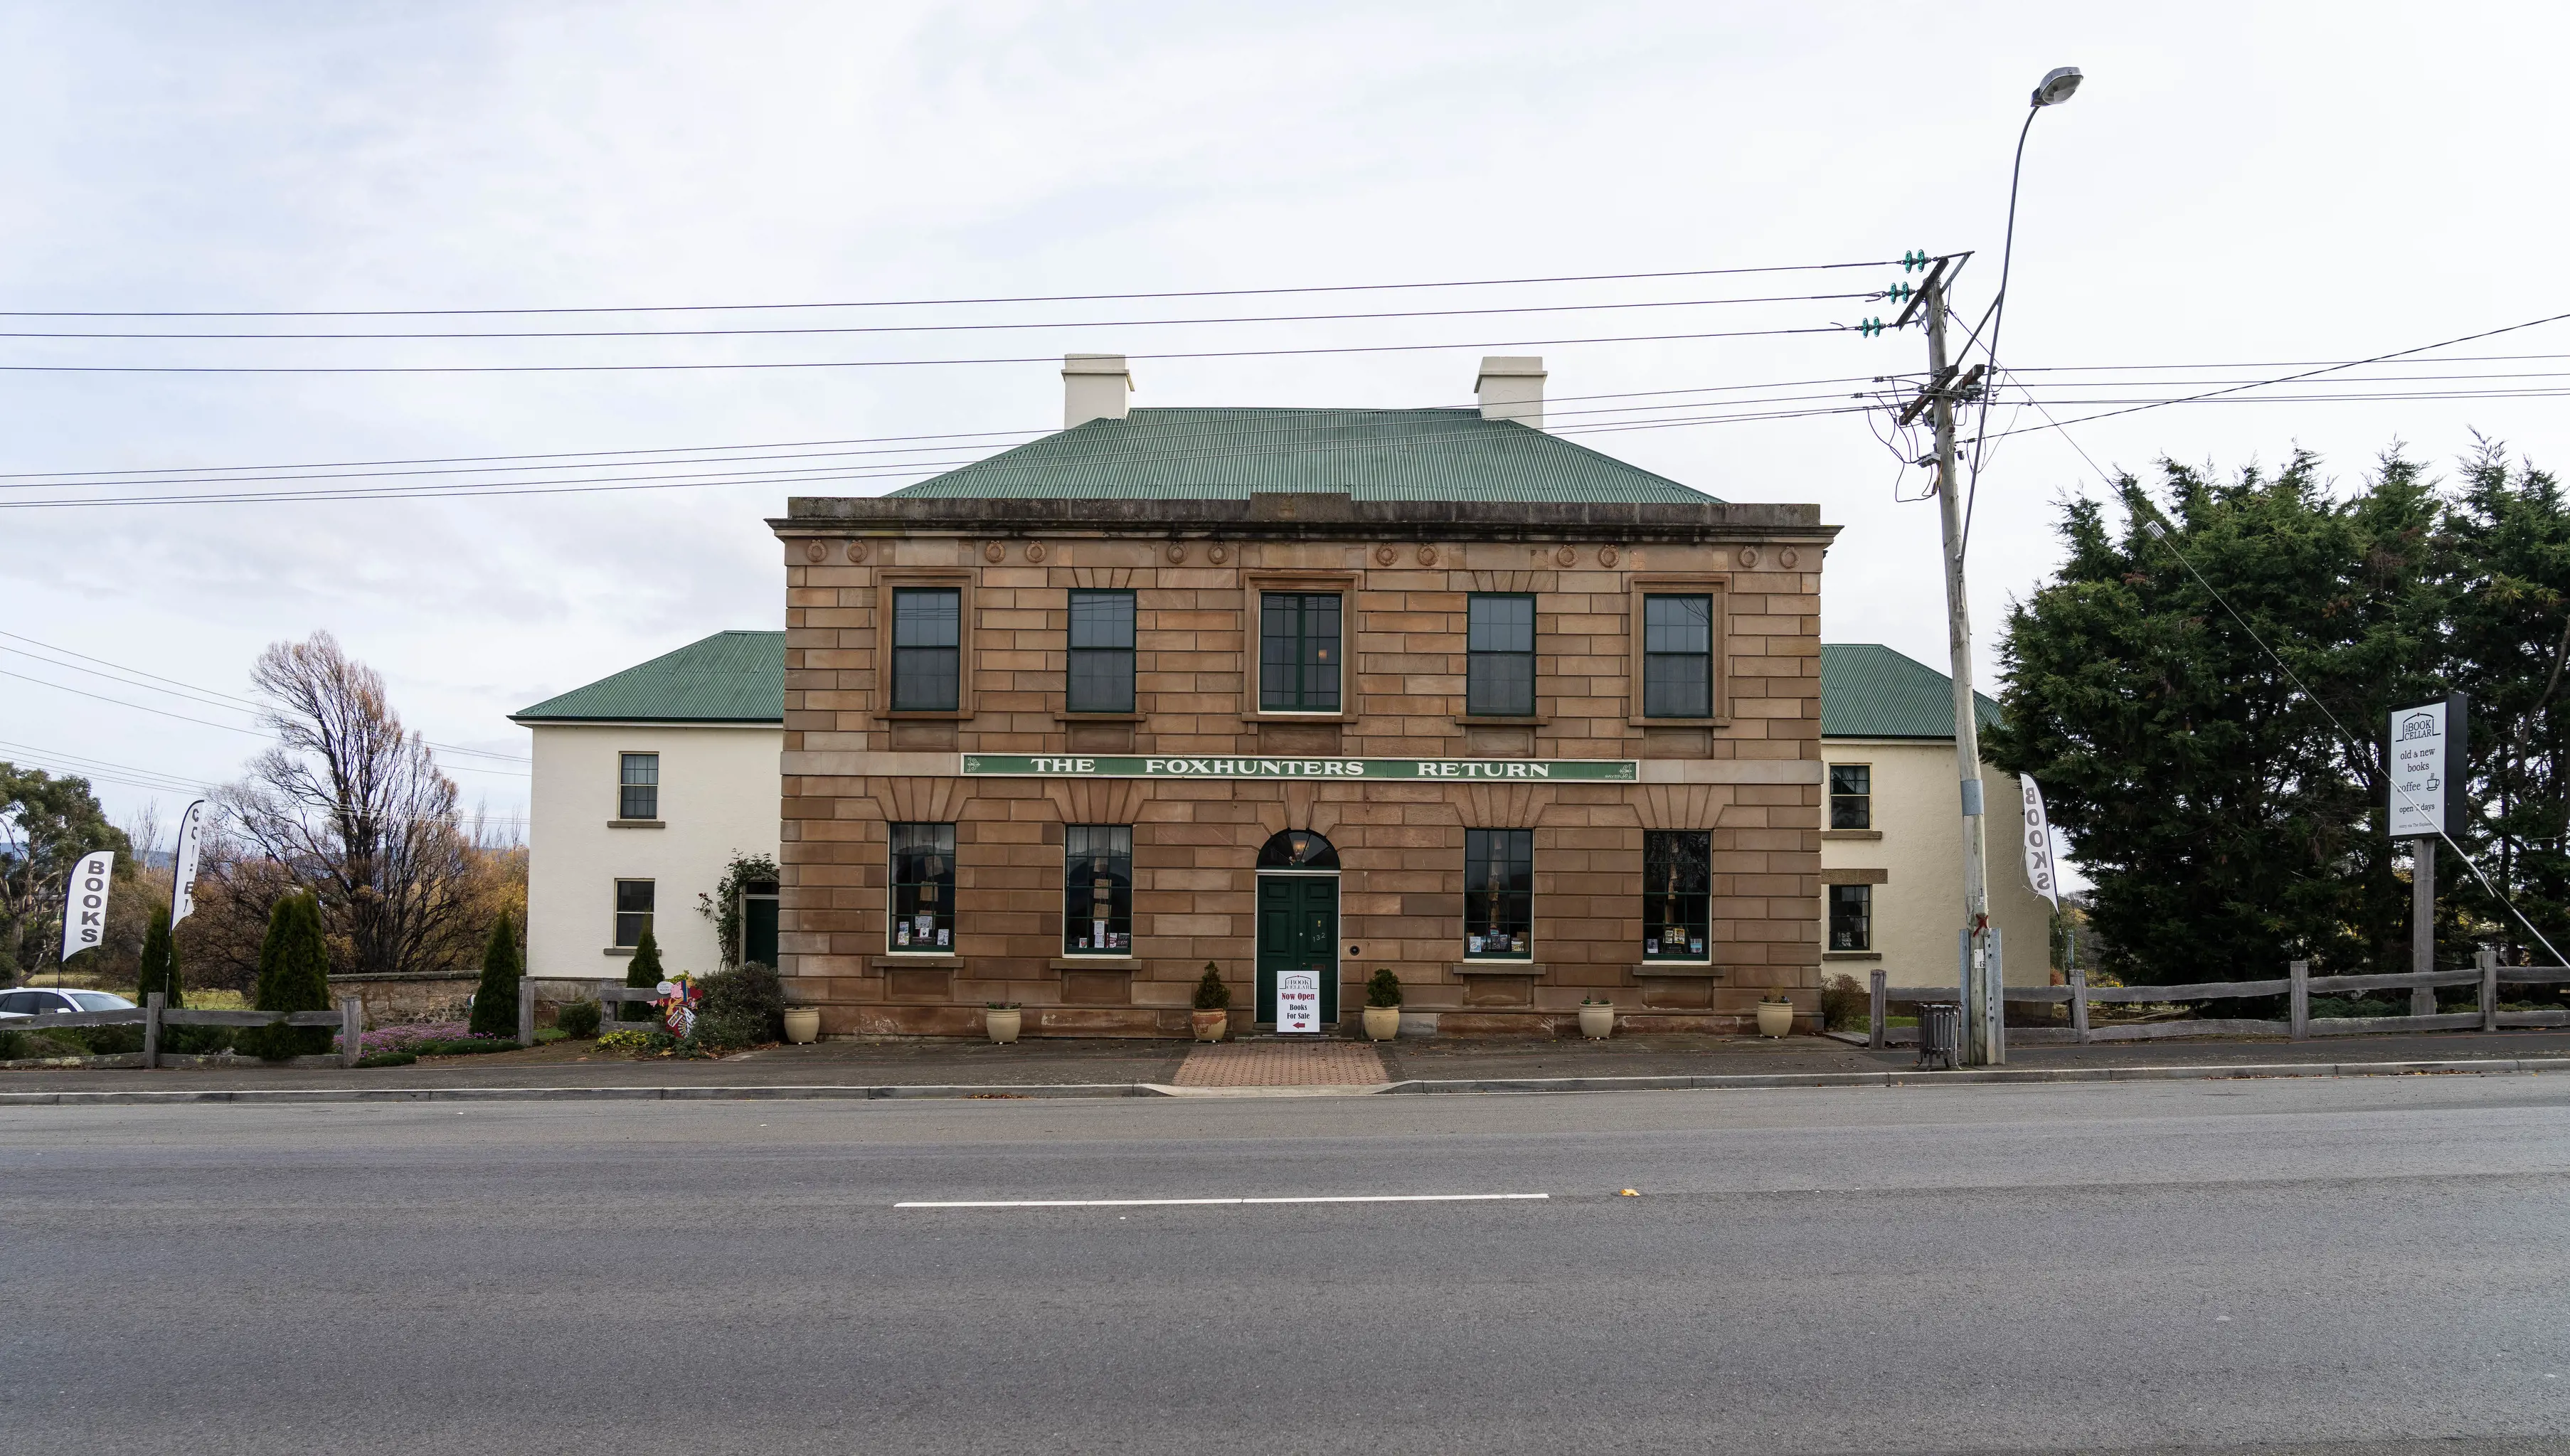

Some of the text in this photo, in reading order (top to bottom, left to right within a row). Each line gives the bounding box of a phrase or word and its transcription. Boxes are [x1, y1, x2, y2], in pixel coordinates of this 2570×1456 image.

[2409, 720, 2431, 732] BOOK
[2404, 729, 2431, 740] CELLAR
[2400, 749, 2412, 760] old
[2420, 748, 2436, 757] new
[1031, 758, 1550, 777] THE FOXHUNTERS RETURN
[2407, 761, 2429, 772] books
[2397, 782, 2421, 792] coffee
[2399, 805, 2414, 814] open
[2421, 803, 2435, 812] days
[80, 860, 105, 942] BOOKS
[1312, 932, 1326, 942] 132
[1297, 992, 1315, 1001] Open
